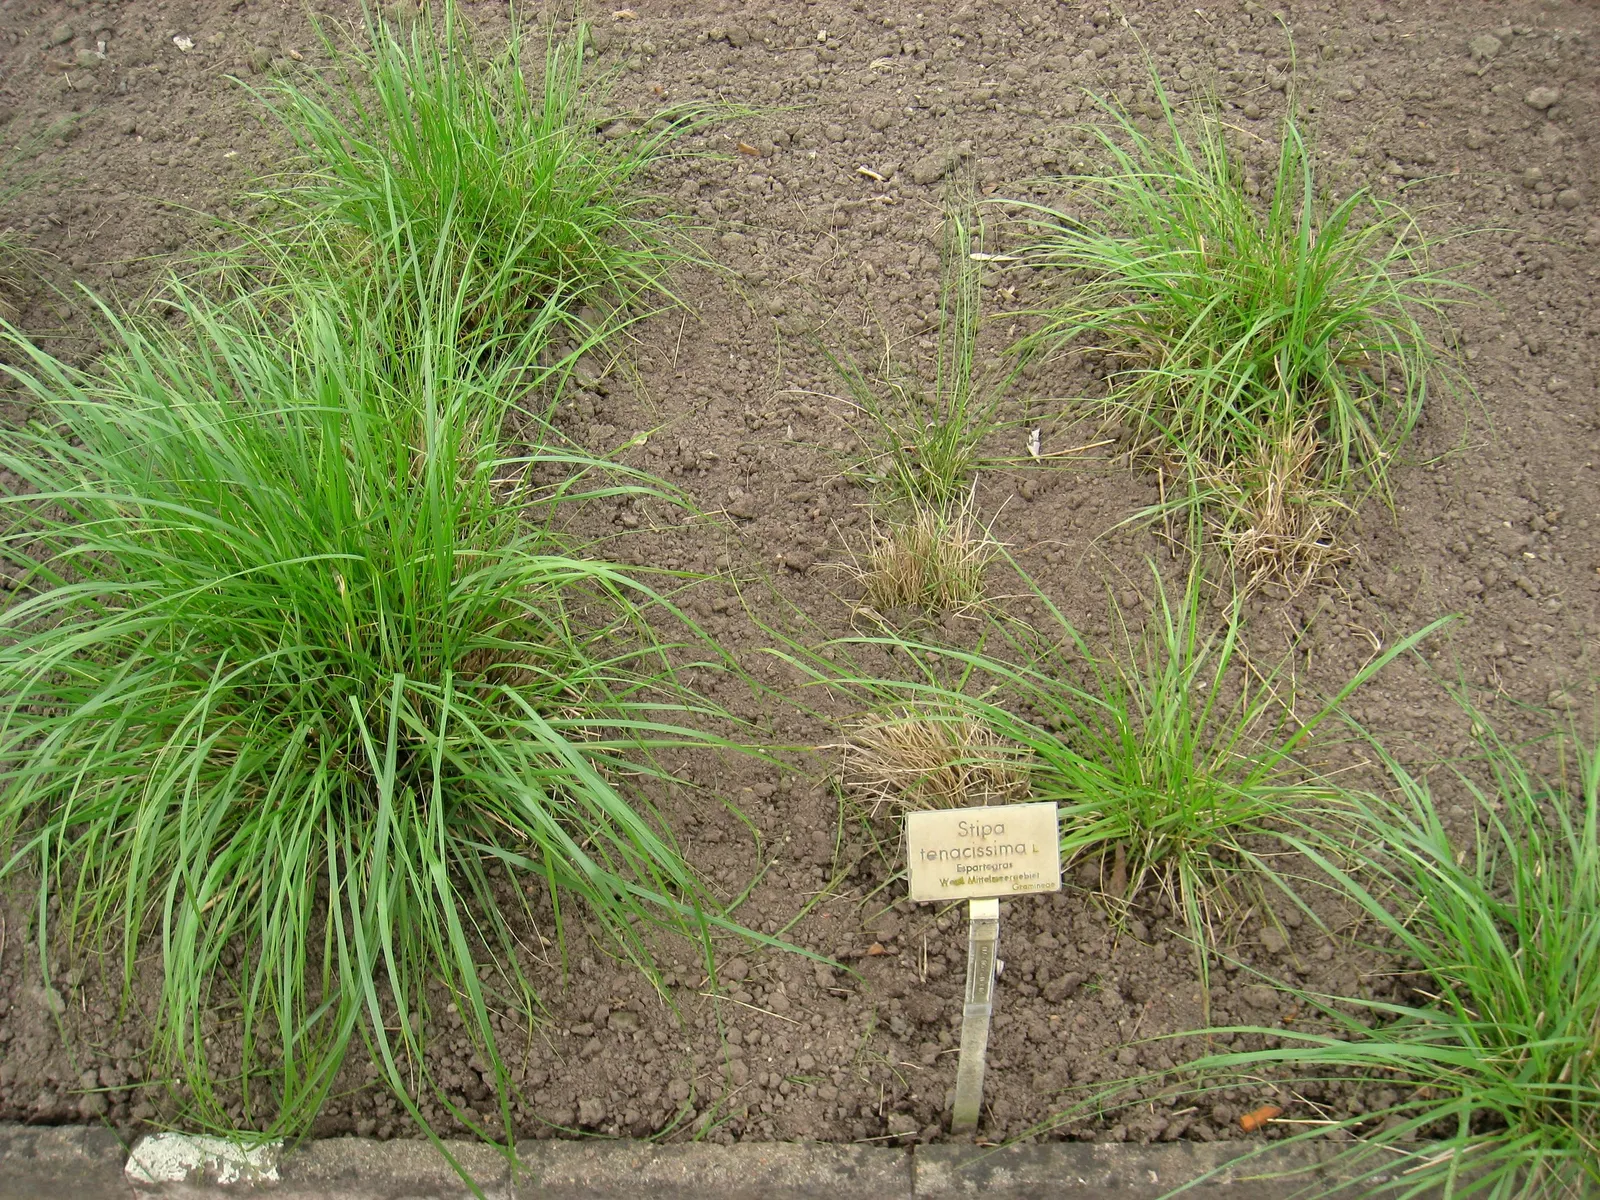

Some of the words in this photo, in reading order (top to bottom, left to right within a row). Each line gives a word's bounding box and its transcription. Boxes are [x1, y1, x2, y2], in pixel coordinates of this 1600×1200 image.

[958, 820, 1005, 839] Stipa
[920, 840, 1026, 862] tenacissima
[1012, 881, 1055, 891] Gramineae
